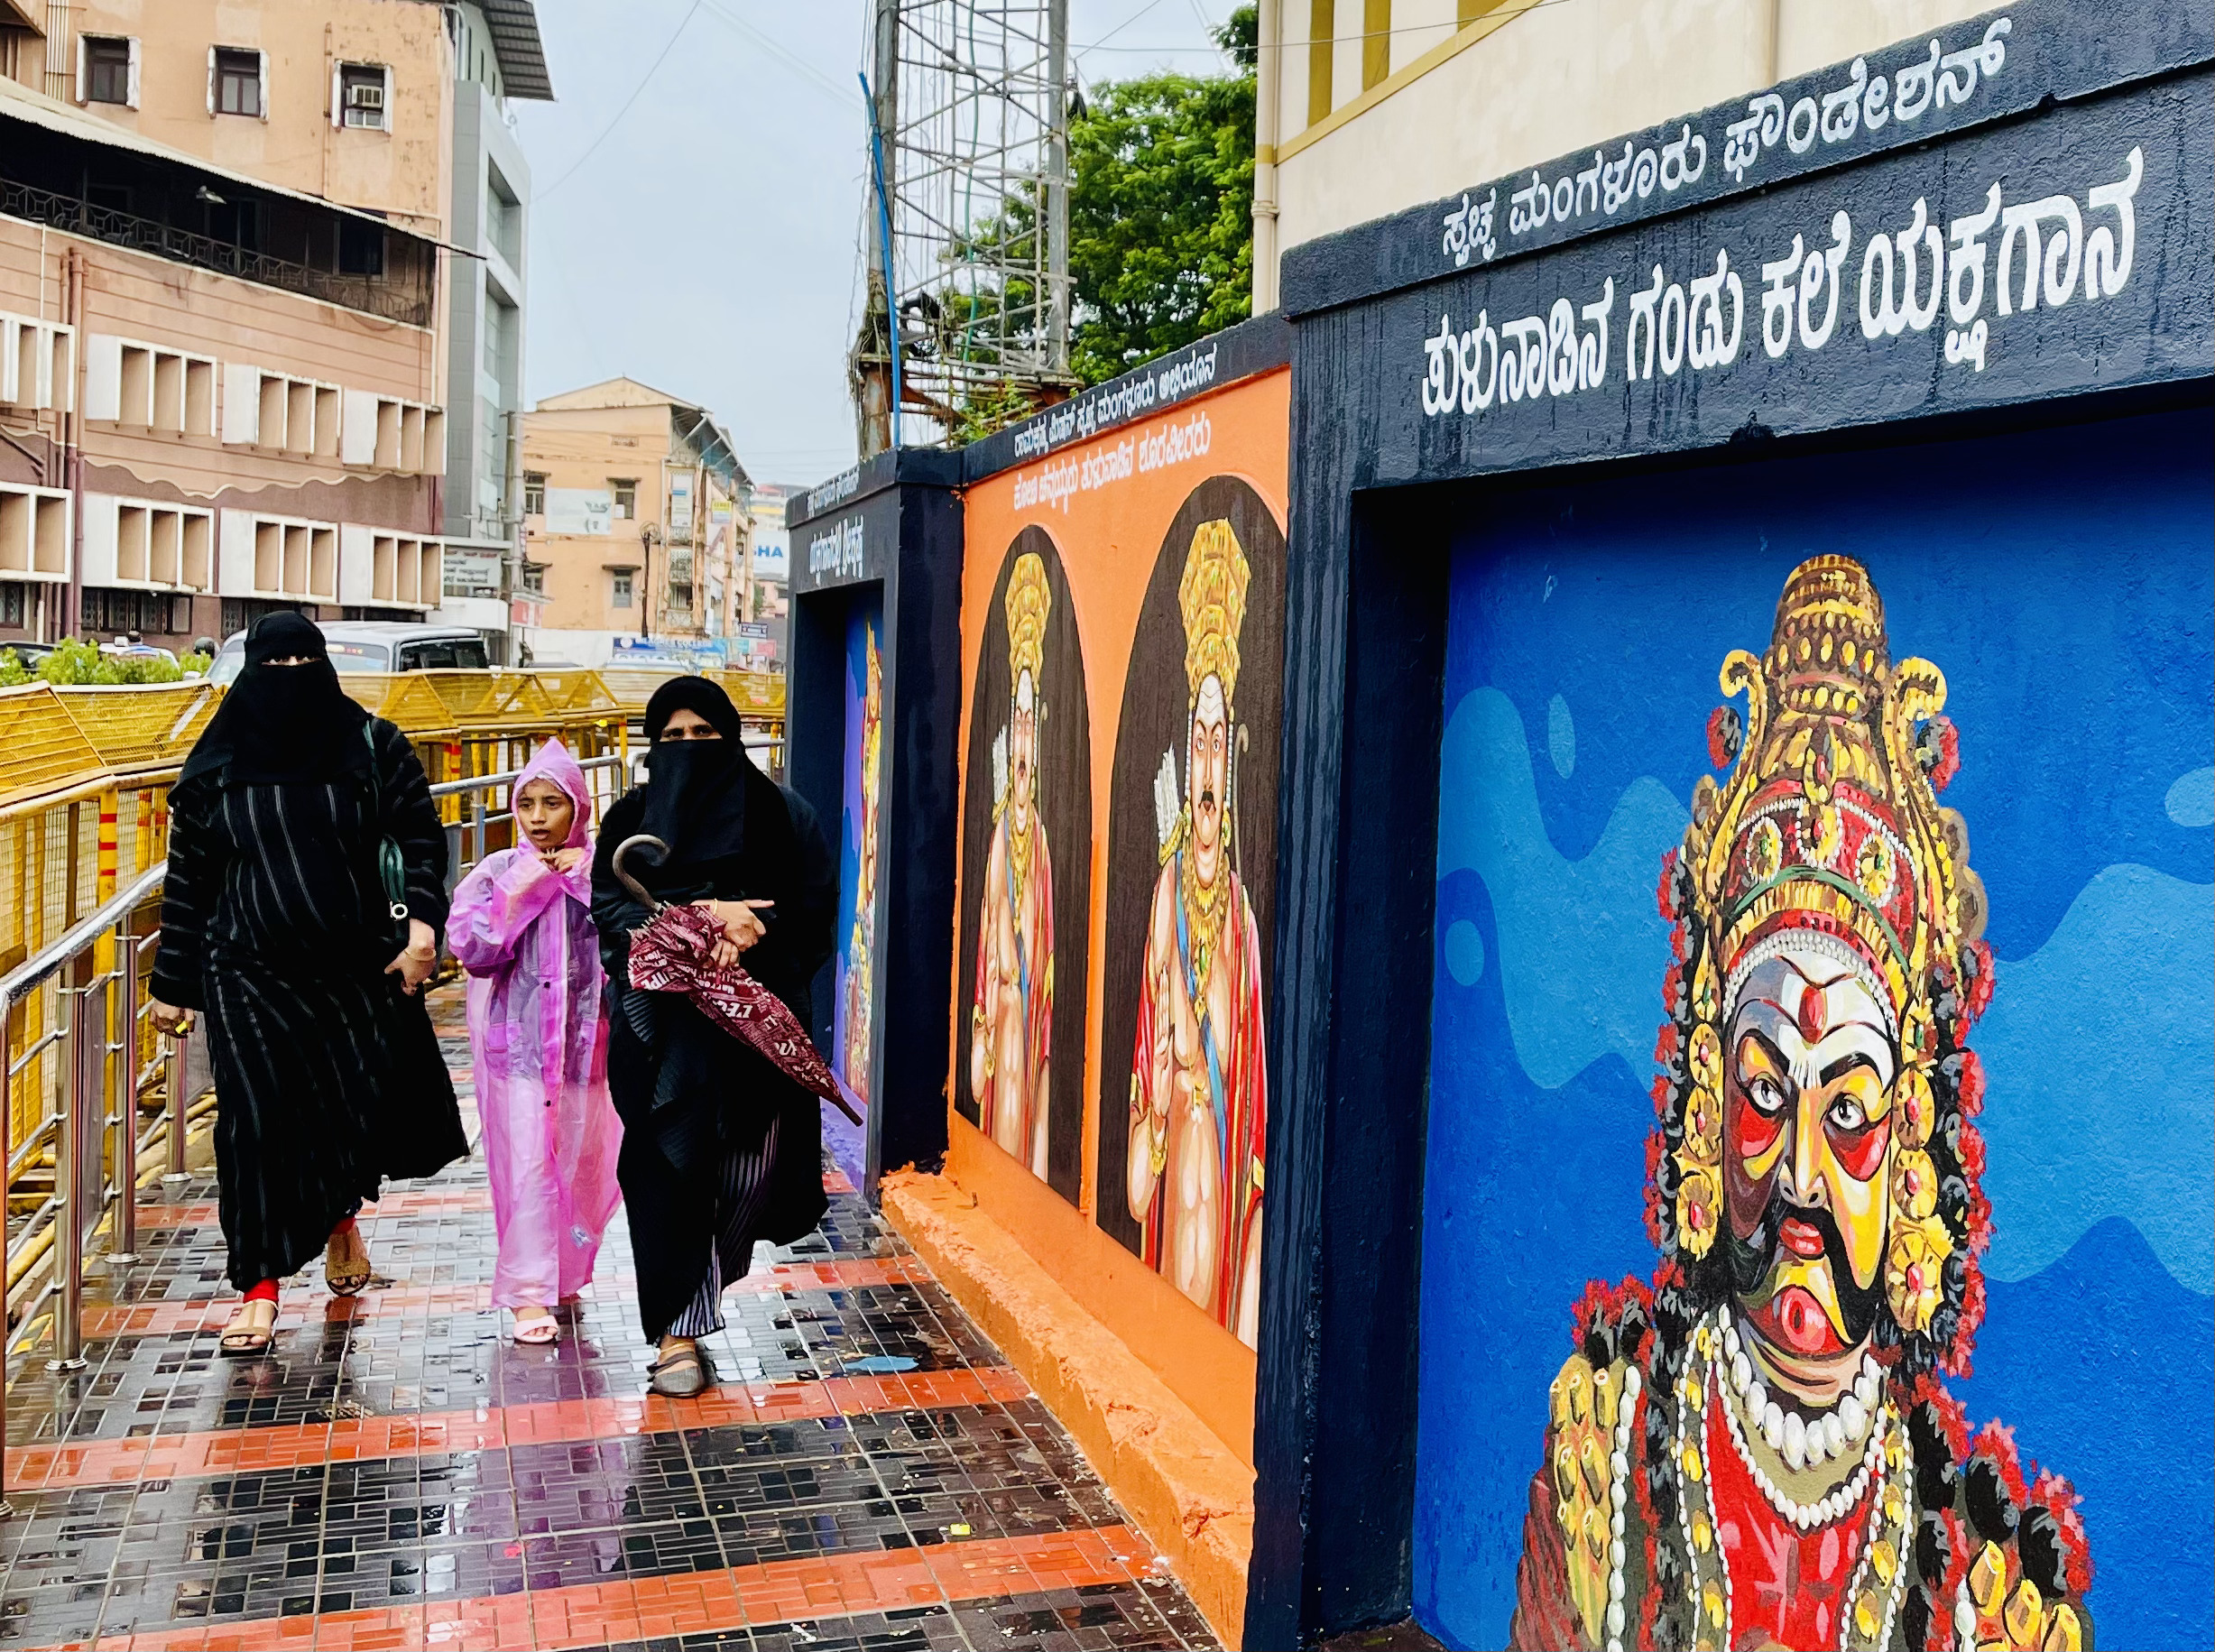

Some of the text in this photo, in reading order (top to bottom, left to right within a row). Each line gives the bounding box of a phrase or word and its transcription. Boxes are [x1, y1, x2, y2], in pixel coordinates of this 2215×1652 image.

[1509, 124, 1706, 235] ಮಂಗಳೂರು
[1723, 16, 2013, 183] ಫೌಂಡೇಶನ್
[1422, 146, 2144, 416] ತುಳುನಾಡಿನ ಗಂಡು ಕಲೆ ಯಕ್ಷಗಾನ
[1098, 371, 1155, 424] ಮಂಗಳೂರು
